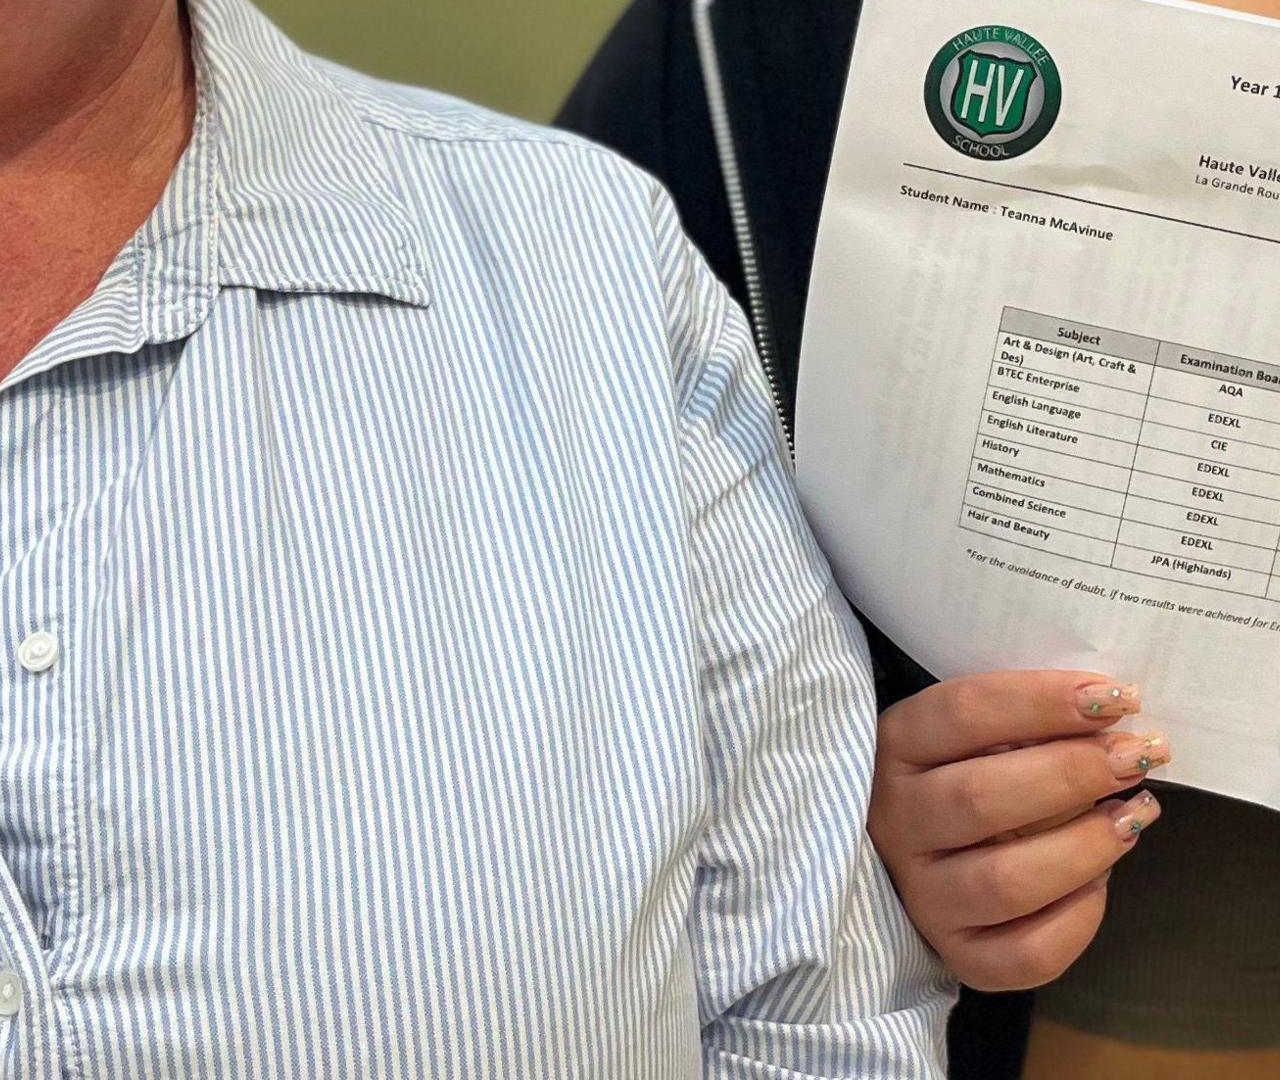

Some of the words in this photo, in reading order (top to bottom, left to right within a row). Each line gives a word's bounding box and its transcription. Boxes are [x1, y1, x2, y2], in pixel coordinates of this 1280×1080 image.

[952, 27, 1000, 51] HAUTE
[960, 59, 1024, 127] HV
[1230, 75, 1269, 97] Year
[952, 134, 1010, 158] SCHOOL
[1199, 154, 1244, 175] Haute
[1195, 175, 1208, 186] La
[1211, 177, 1254, 196] Grande
[900, 185, 949, 206] Student
[952, 196, 990, 214] Name
[1000, 205, 1046, 226] Teanna
[1049, 216, 1114, 241] McAvinue
[1057, 326, 1101, 345] Subject
[1000, 350, 1024, 366] Des)
[1003, 335, 1020, 348] Art
[1022, 341, 1032, 350] &
[1034, 342, 1070, 360] Design
[1072, 350, 1096, 367] (Art,
[1099, 356, 1125, 372] Craft
[1127, 364, 1137, 375] &
[1180, 354, 1253, 377] Examination
[997, 366, 1024, 382] BTEC
[1025, 372, 1080, 393] Enterprise
[1218, 384, 1244, 398] AQA
[992, 391, 1029, 408] English
[1031, 399, 1081, 420] Language
[987, 414, 1024, 432] English
[1026, 422, 1078, 444] Literature
[1208, 413, 1241, 429] EDEXL
[981, 438, 1020, 457] History
[1211, 439, 1229, 451] CIE
[977, 462, 1045, 488] Mathematics
[1197, 462, 1230, 478] EDEXL
[972, 486, 1025, 509] Combined
[1027, 499, 1067, 519] Science
[1191, 487, 1225, 502] EDEXL
[967, 509, 989, 523] Hair
[991, 514, 1011, 528] and
[1013, 520, 1051, 541] Beauty
[1186, 511, 1219, 526] EDEXL
[1180, 536, 1214, 551] EDEXL
[1150, 555, 1170, 568] JPA
[1172, 558, 1232, 580] (Highlands)
[989, 556, 1006, 569] the
[1007, 562, 1059, 585] avoidance
[1061, 577, 1073, 589] of
[1074, 579, 1107, 599] doubt,
[1109, 588, 1118, 600] if
[1119, 591, 1139, 604] two
[1141, 596, 1175, 611] results
[1177, 604, 1203, 616] were
[1205, 607, 1250, 625] achieved
[1252, 616, 1268, 629] for
